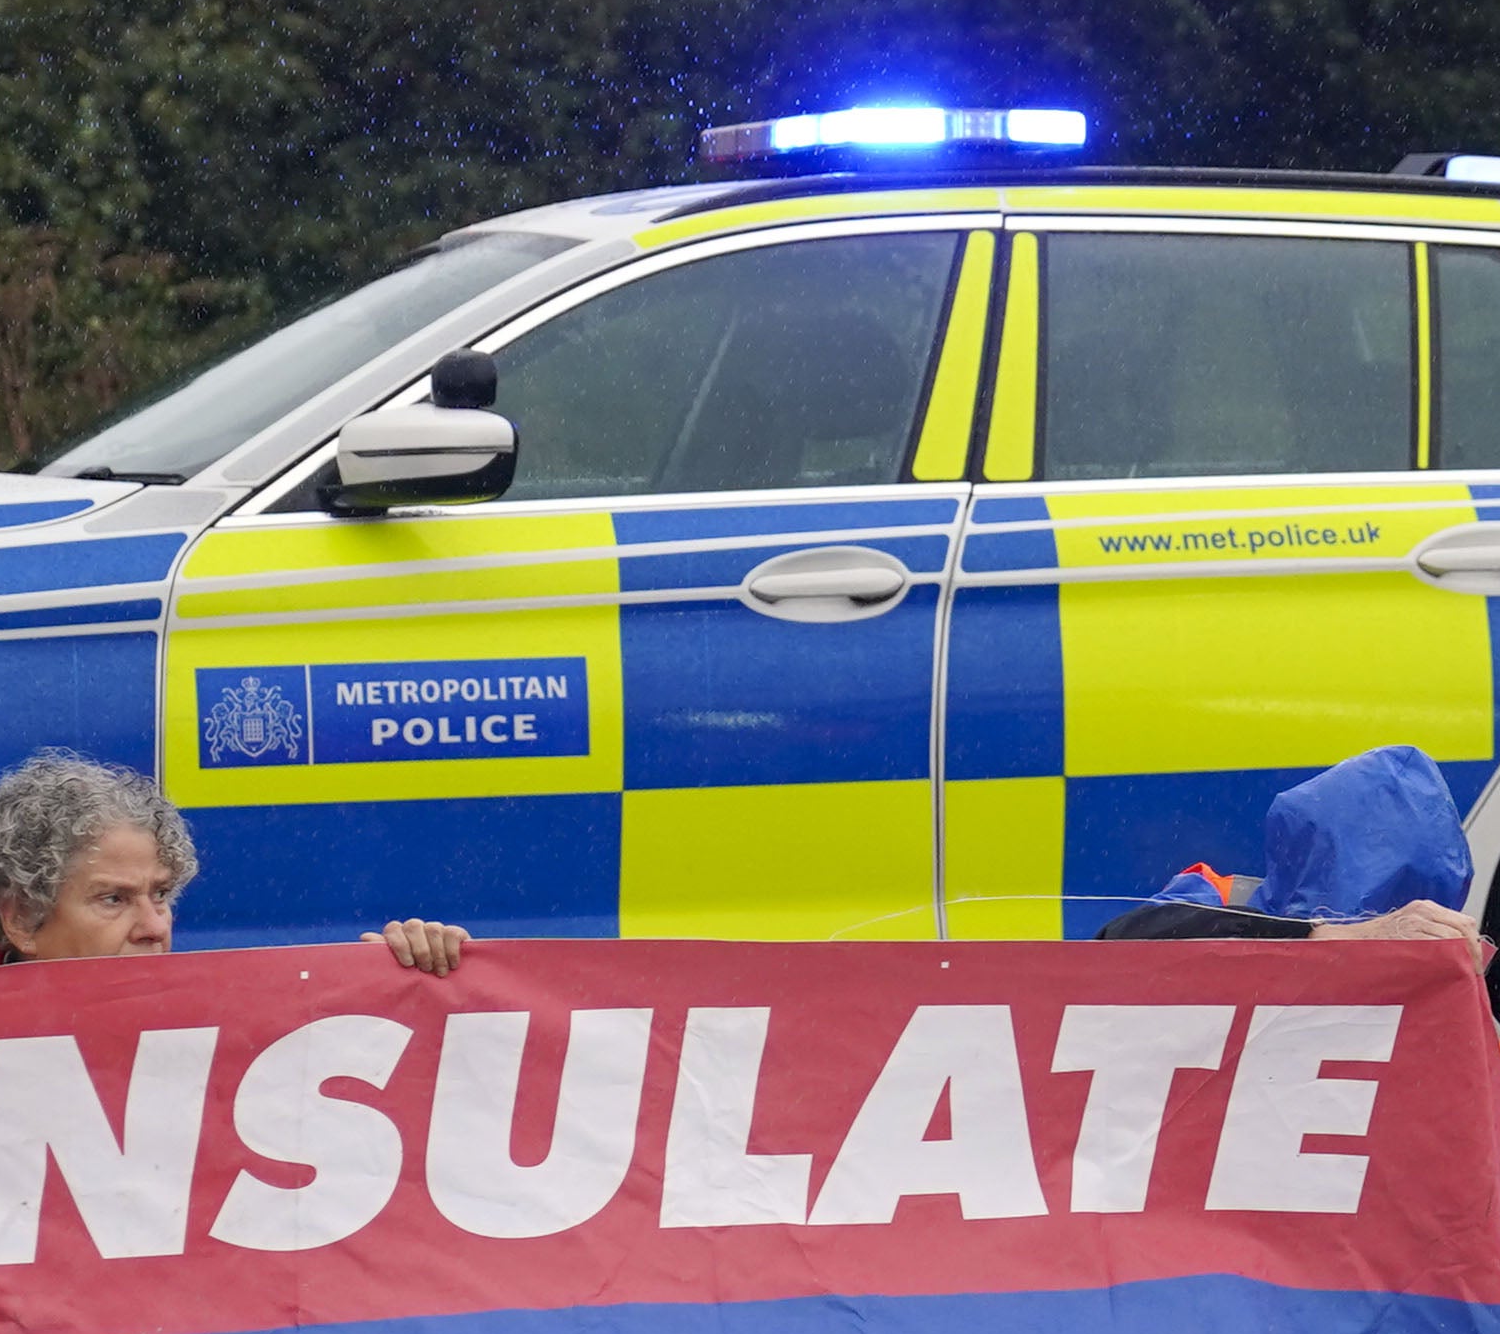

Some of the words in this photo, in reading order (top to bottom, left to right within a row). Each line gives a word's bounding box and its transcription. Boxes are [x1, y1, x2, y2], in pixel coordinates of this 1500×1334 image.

[1098, 521, 1381, 554] www.met.police.uk
[336, 675, 568, 706] METROPOLITAN
[371, 713, 538, 746] POLICE
